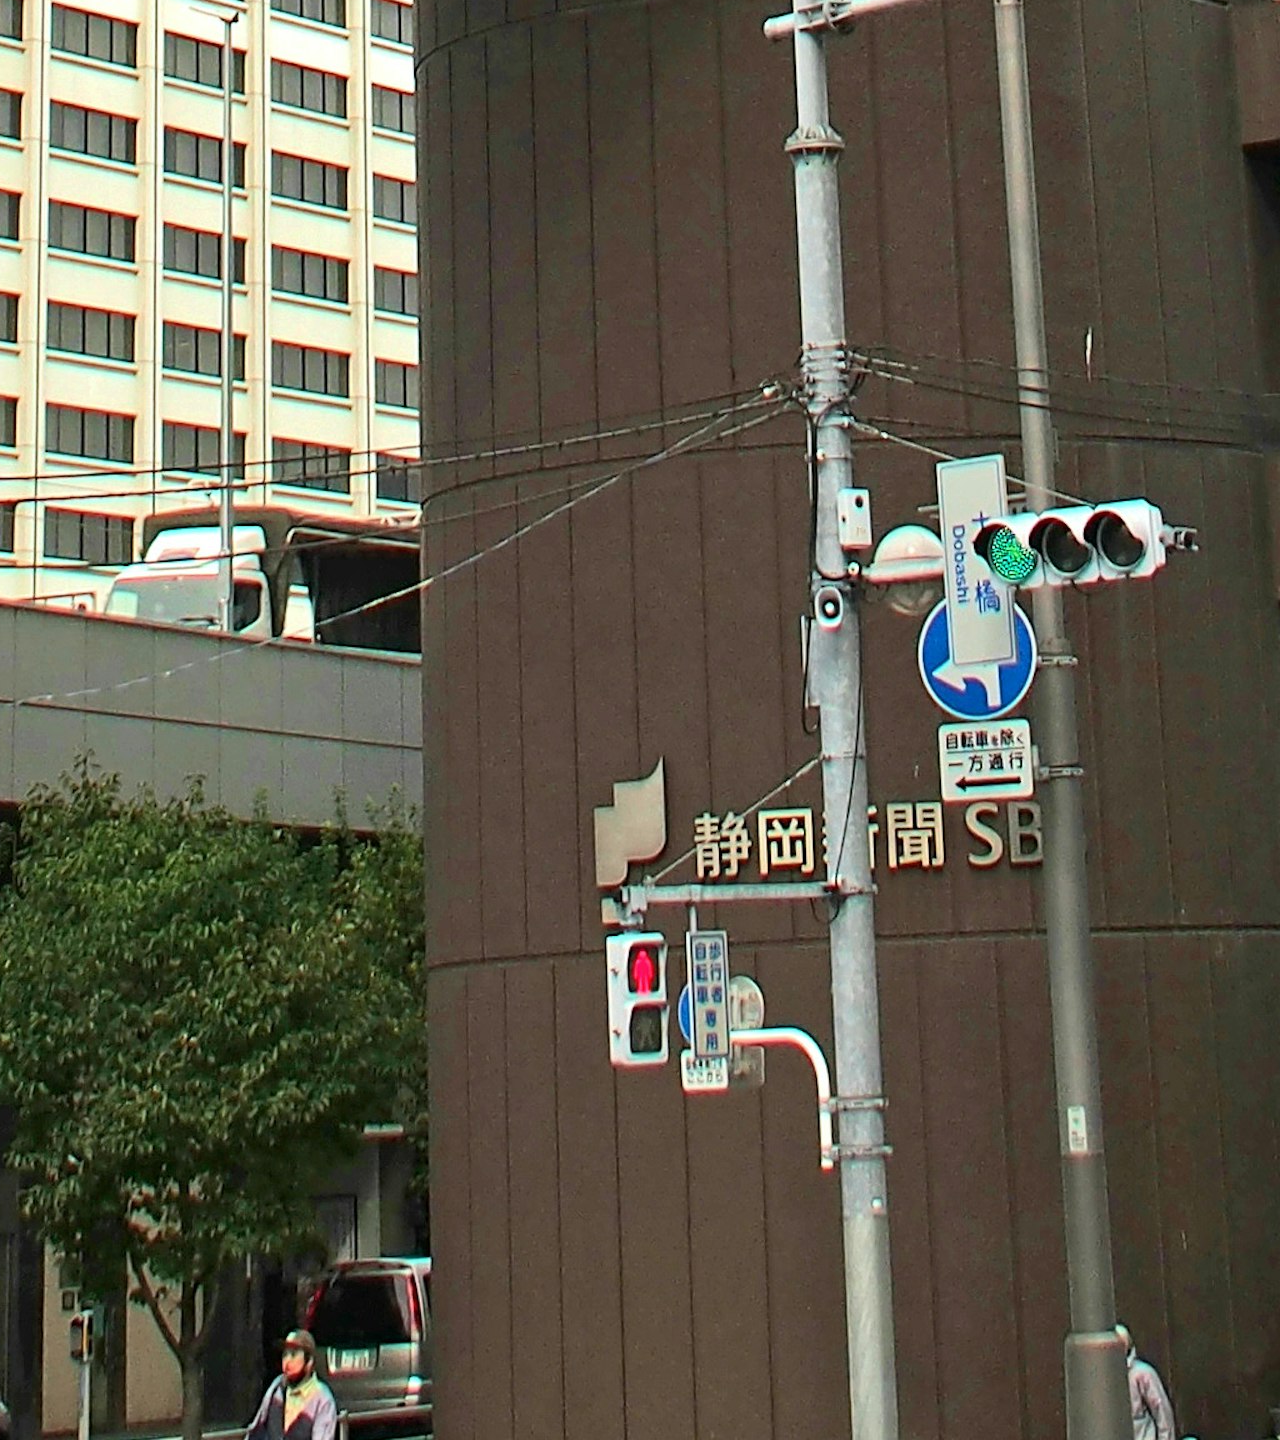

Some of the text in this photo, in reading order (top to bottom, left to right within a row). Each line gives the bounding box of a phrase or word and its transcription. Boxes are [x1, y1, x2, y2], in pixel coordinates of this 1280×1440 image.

[952, 524, 970, 605] Dobashi
[946, 728, 1024, 749] 自転車を除く
[948, 752, 1024, 773] 一方通行
[694, 802, 945, 879] 静岡聞
